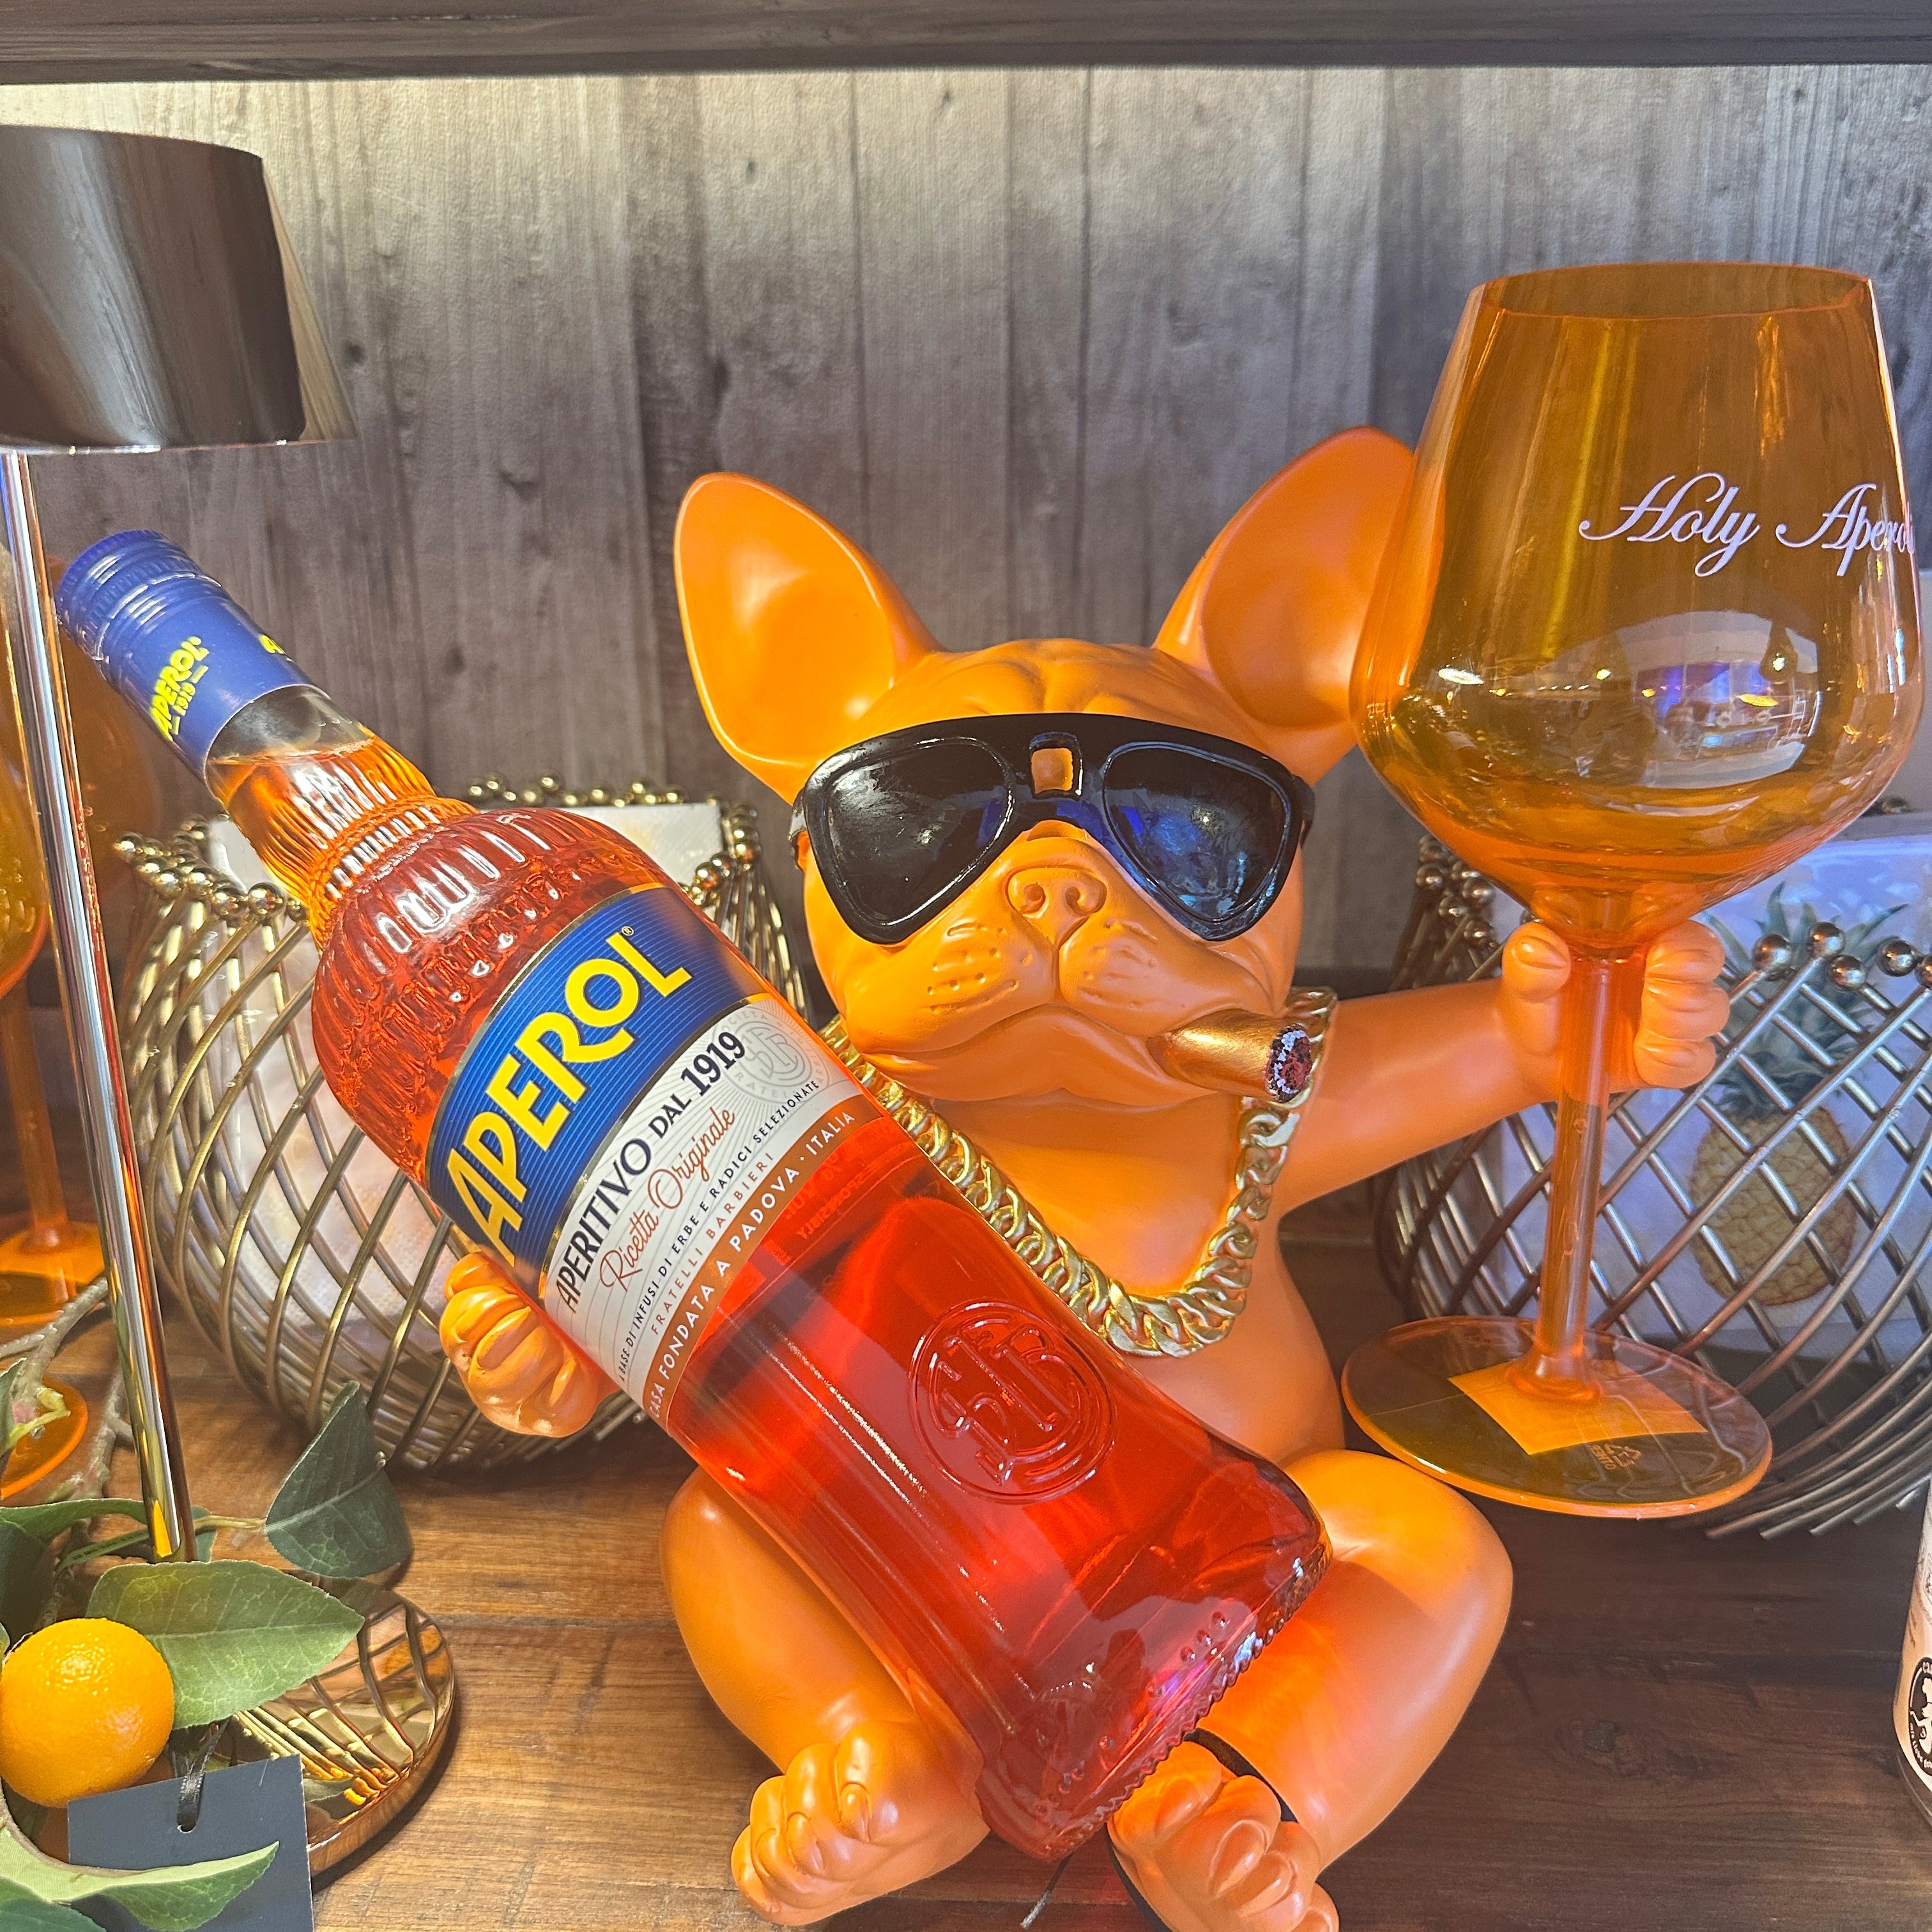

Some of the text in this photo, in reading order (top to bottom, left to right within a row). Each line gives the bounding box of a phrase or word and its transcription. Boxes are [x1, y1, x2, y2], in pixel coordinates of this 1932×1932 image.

[1579, 473, 1761, 578] Holy
[149, 637, 210, 741] APEROL
[447, 930, 693, 1269] APEROL
[556, 1031, 746, 1314] APERITIVO DAL 1919
[599, 1107, 735, 1292] Ricetta Originale
[618, 1348, 630, 1375] BASE
[625, 1331, 636, 1347] DI
[632, 1280, 659, 1330] INFUSI
[658, 1258, 672, 1277] DI
[671, 1215, 699, 1254] ERBE
[700, 1201, 709, 1212] E
[709, 1146, 752, 1199] RADICI
[753, 1080, 819, 1144] SELEZIONATE
[649, 1383, 665, 1418] CASA
[658, 1285, 715, 1380] FONDATA
[716, 1261, 731, 1277] A
[729, 1167, 800, 1252] PADOVA
[805, 1112, 855, 1156] ITALIA
[651, 1153, 774, 1335] FRATELLI BARBIERI
